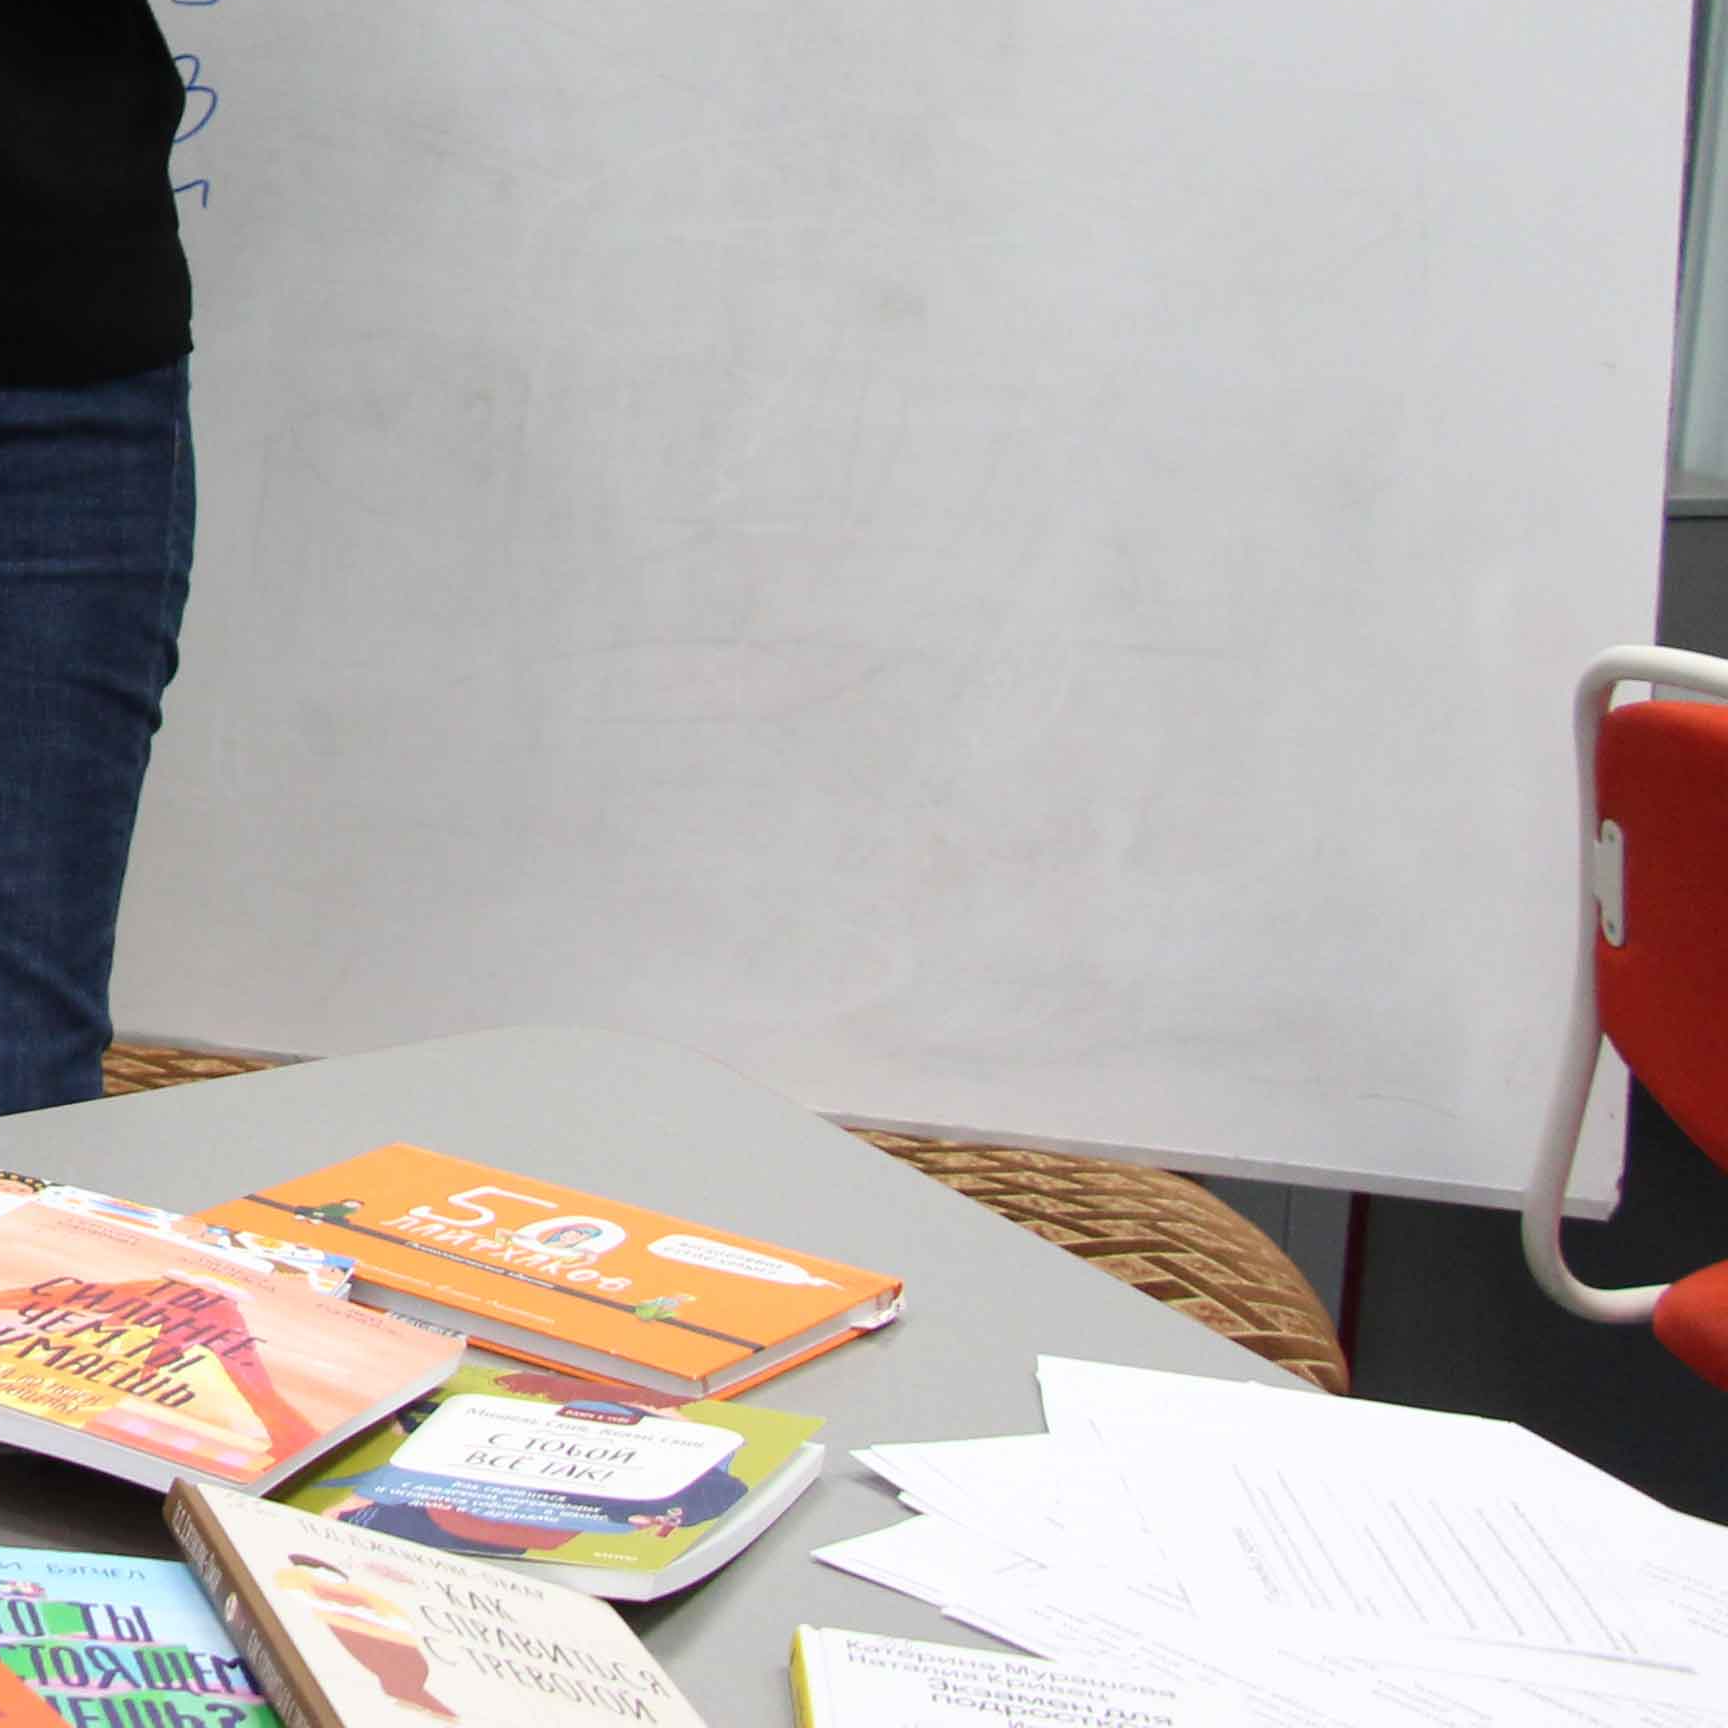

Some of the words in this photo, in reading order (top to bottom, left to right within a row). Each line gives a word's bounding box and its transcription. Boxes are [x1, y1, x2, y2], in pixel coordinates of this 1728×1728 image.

[148, 1274, 227, 1313] ТЫ
[18, 1301, 125, 1349] ЧЕМ
[126, 1335, 206, 1374] ТЫ
[66, 1599, 155, 1644] ТЫ
[437, 1581, 515, 1623] КАК
[419, 1604, 671, 1699] СПРАВИТЬСЯ
[464, 1649, 658, 1725] ТРЕВОГОЙ
[929, 1678, 1093, 1713] Экзамен
